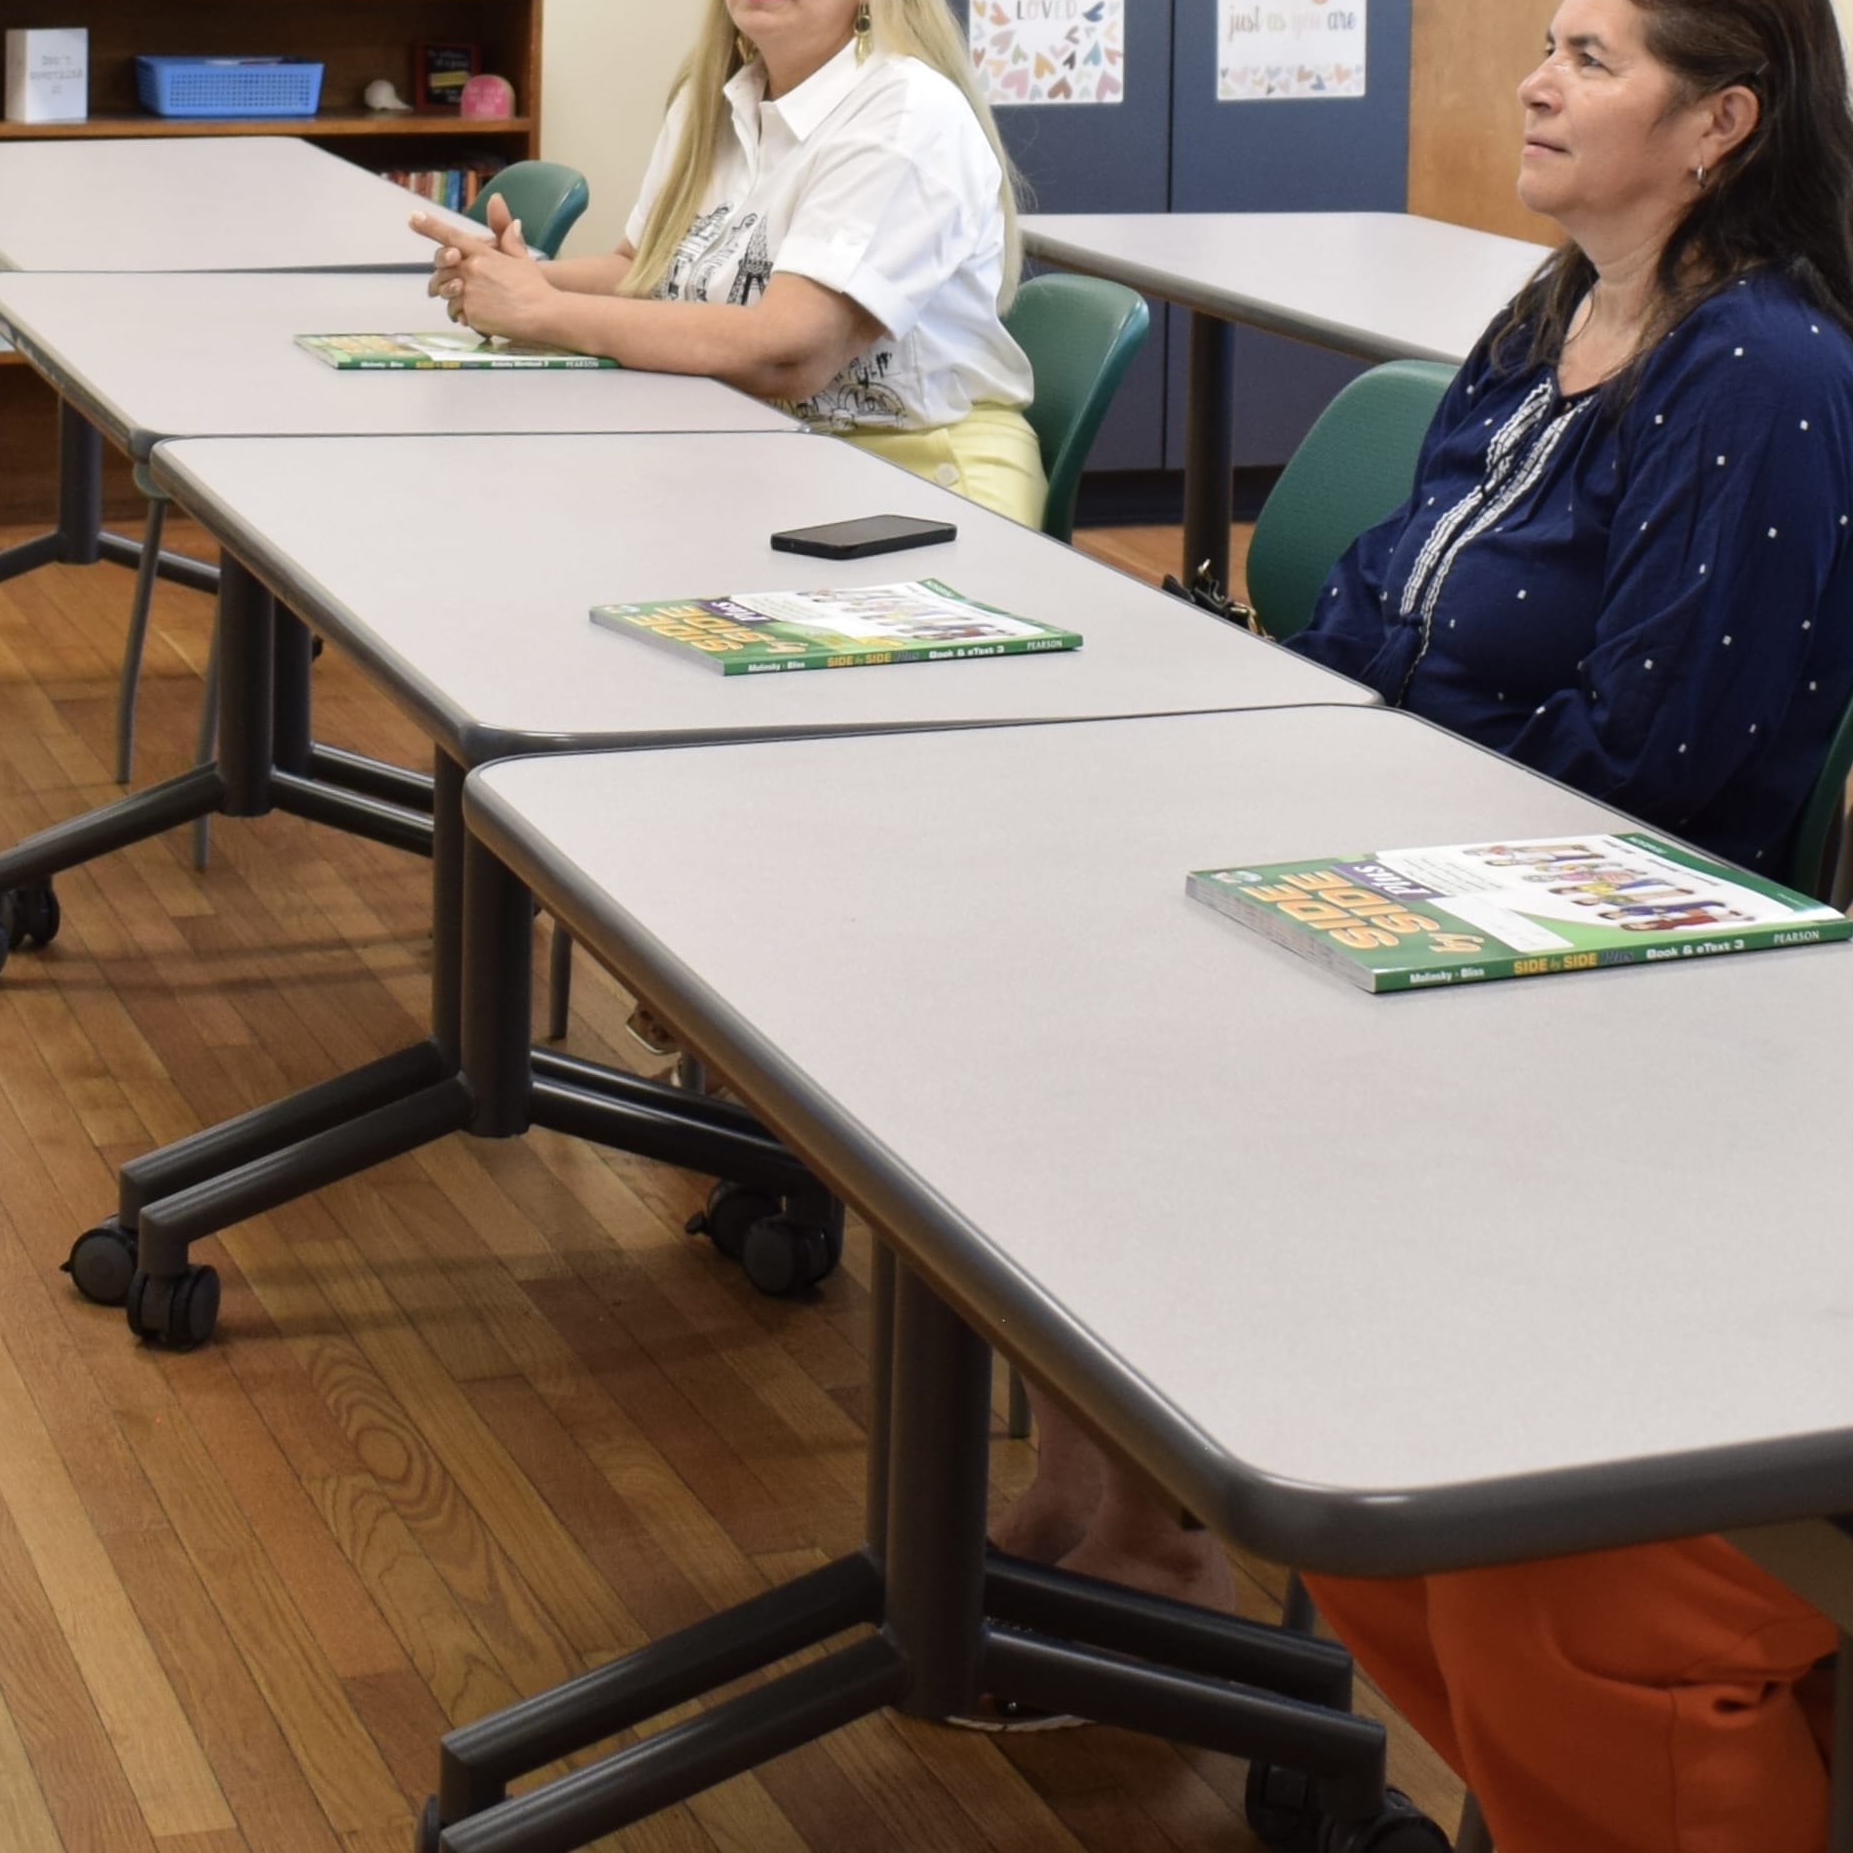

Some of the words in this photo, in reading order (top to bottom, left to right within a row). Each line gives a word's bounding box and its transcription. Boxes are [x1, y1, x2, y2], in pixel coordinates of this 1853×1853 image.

[1016, 0, 1077, 20] LOVED
[1228, 5, 1261, 42] just
[1327, 9, 1357, 31] are
[827, 656, 853, 667] SIDE
[865, 652, 891, 664] SIDE
[929, 649, 954, 660] Book
[967, 646, 994, 658] eText
[997, 645, 1005, 655] 3
[1026, 639, 1063, 652] PEARSON
[1354, 864, 1433, 896] Plus
[1239, 883, 1400, 950] SIDE
[1280, 870, 1441, 934] SIDE
[1410, 972, 1453, 985] Molinsky
[1460, 967, 1485, 979] Bliss
[1513, 957, 1548, 975] SIDE
[1563, 952, 1598, 970] SIDE
[1646, 947, 1680, 959] Book
[1682, 944, 1694, 957] &
[1695, 941, 1730, 955] eText
[1733, 939, 1745, 951] 3
[1774, 930, 1820, 944] PEARSON
